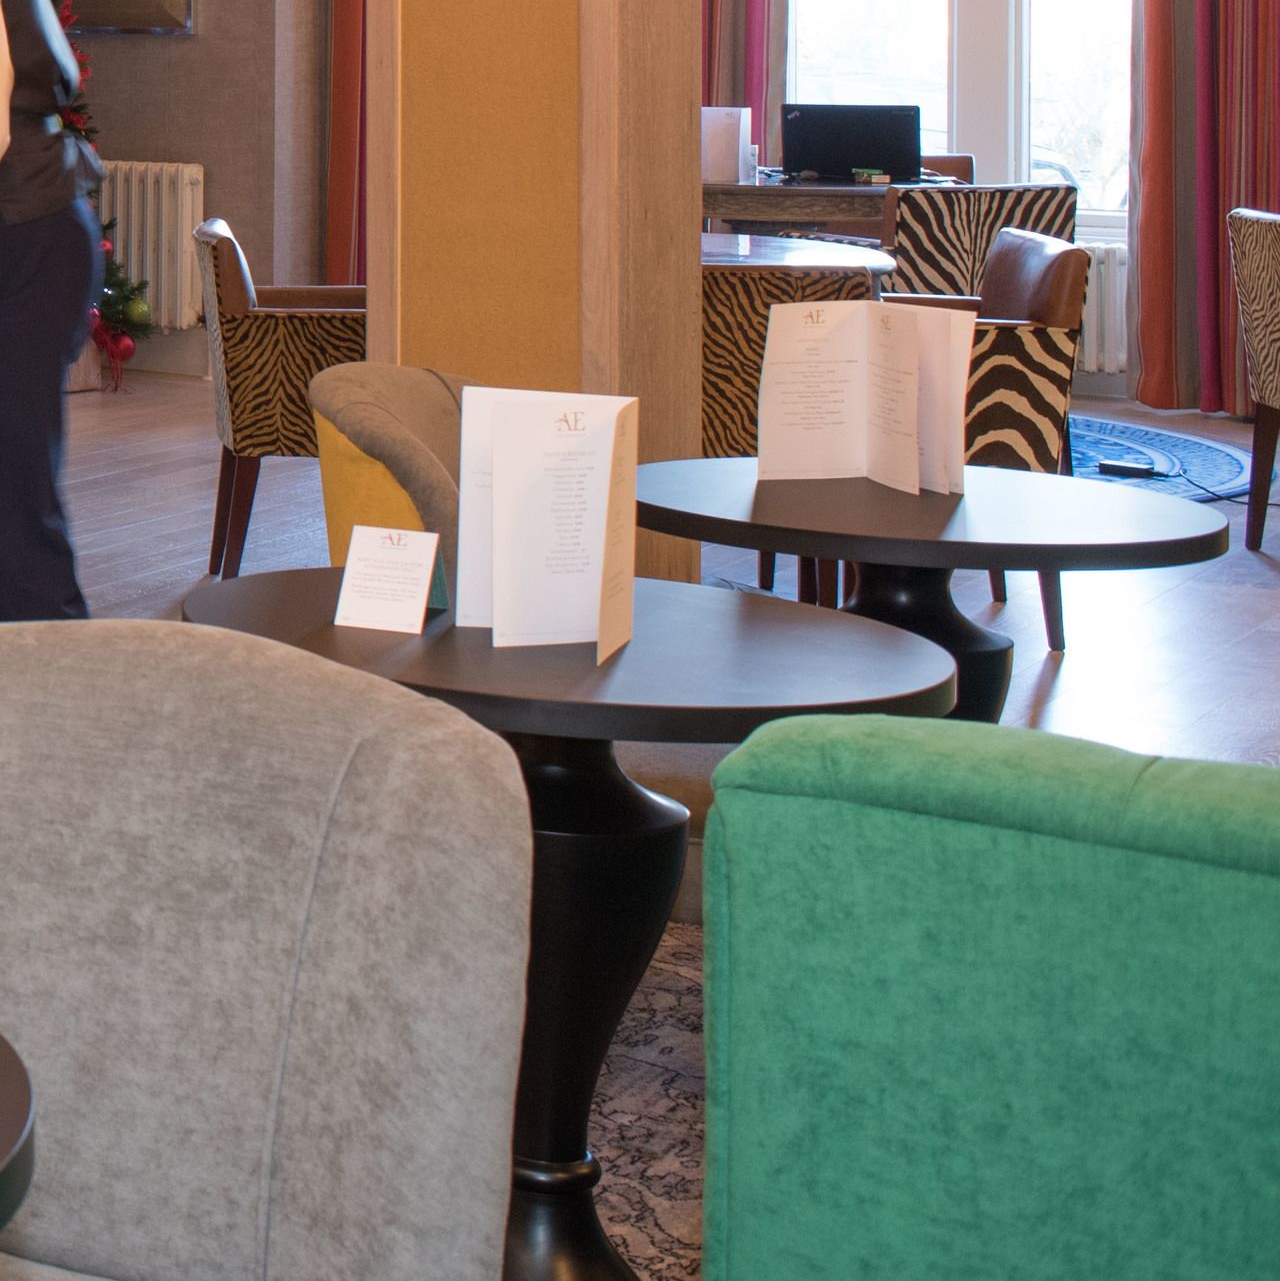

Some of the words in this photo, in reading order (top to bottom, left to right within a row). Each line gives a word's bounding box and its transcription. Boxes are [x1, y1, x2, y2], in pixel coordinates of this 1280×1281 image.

[803, 309, 826, 325] AE
[553, 411, 586, 432] AE
[380, 533, 408, 547] AE
